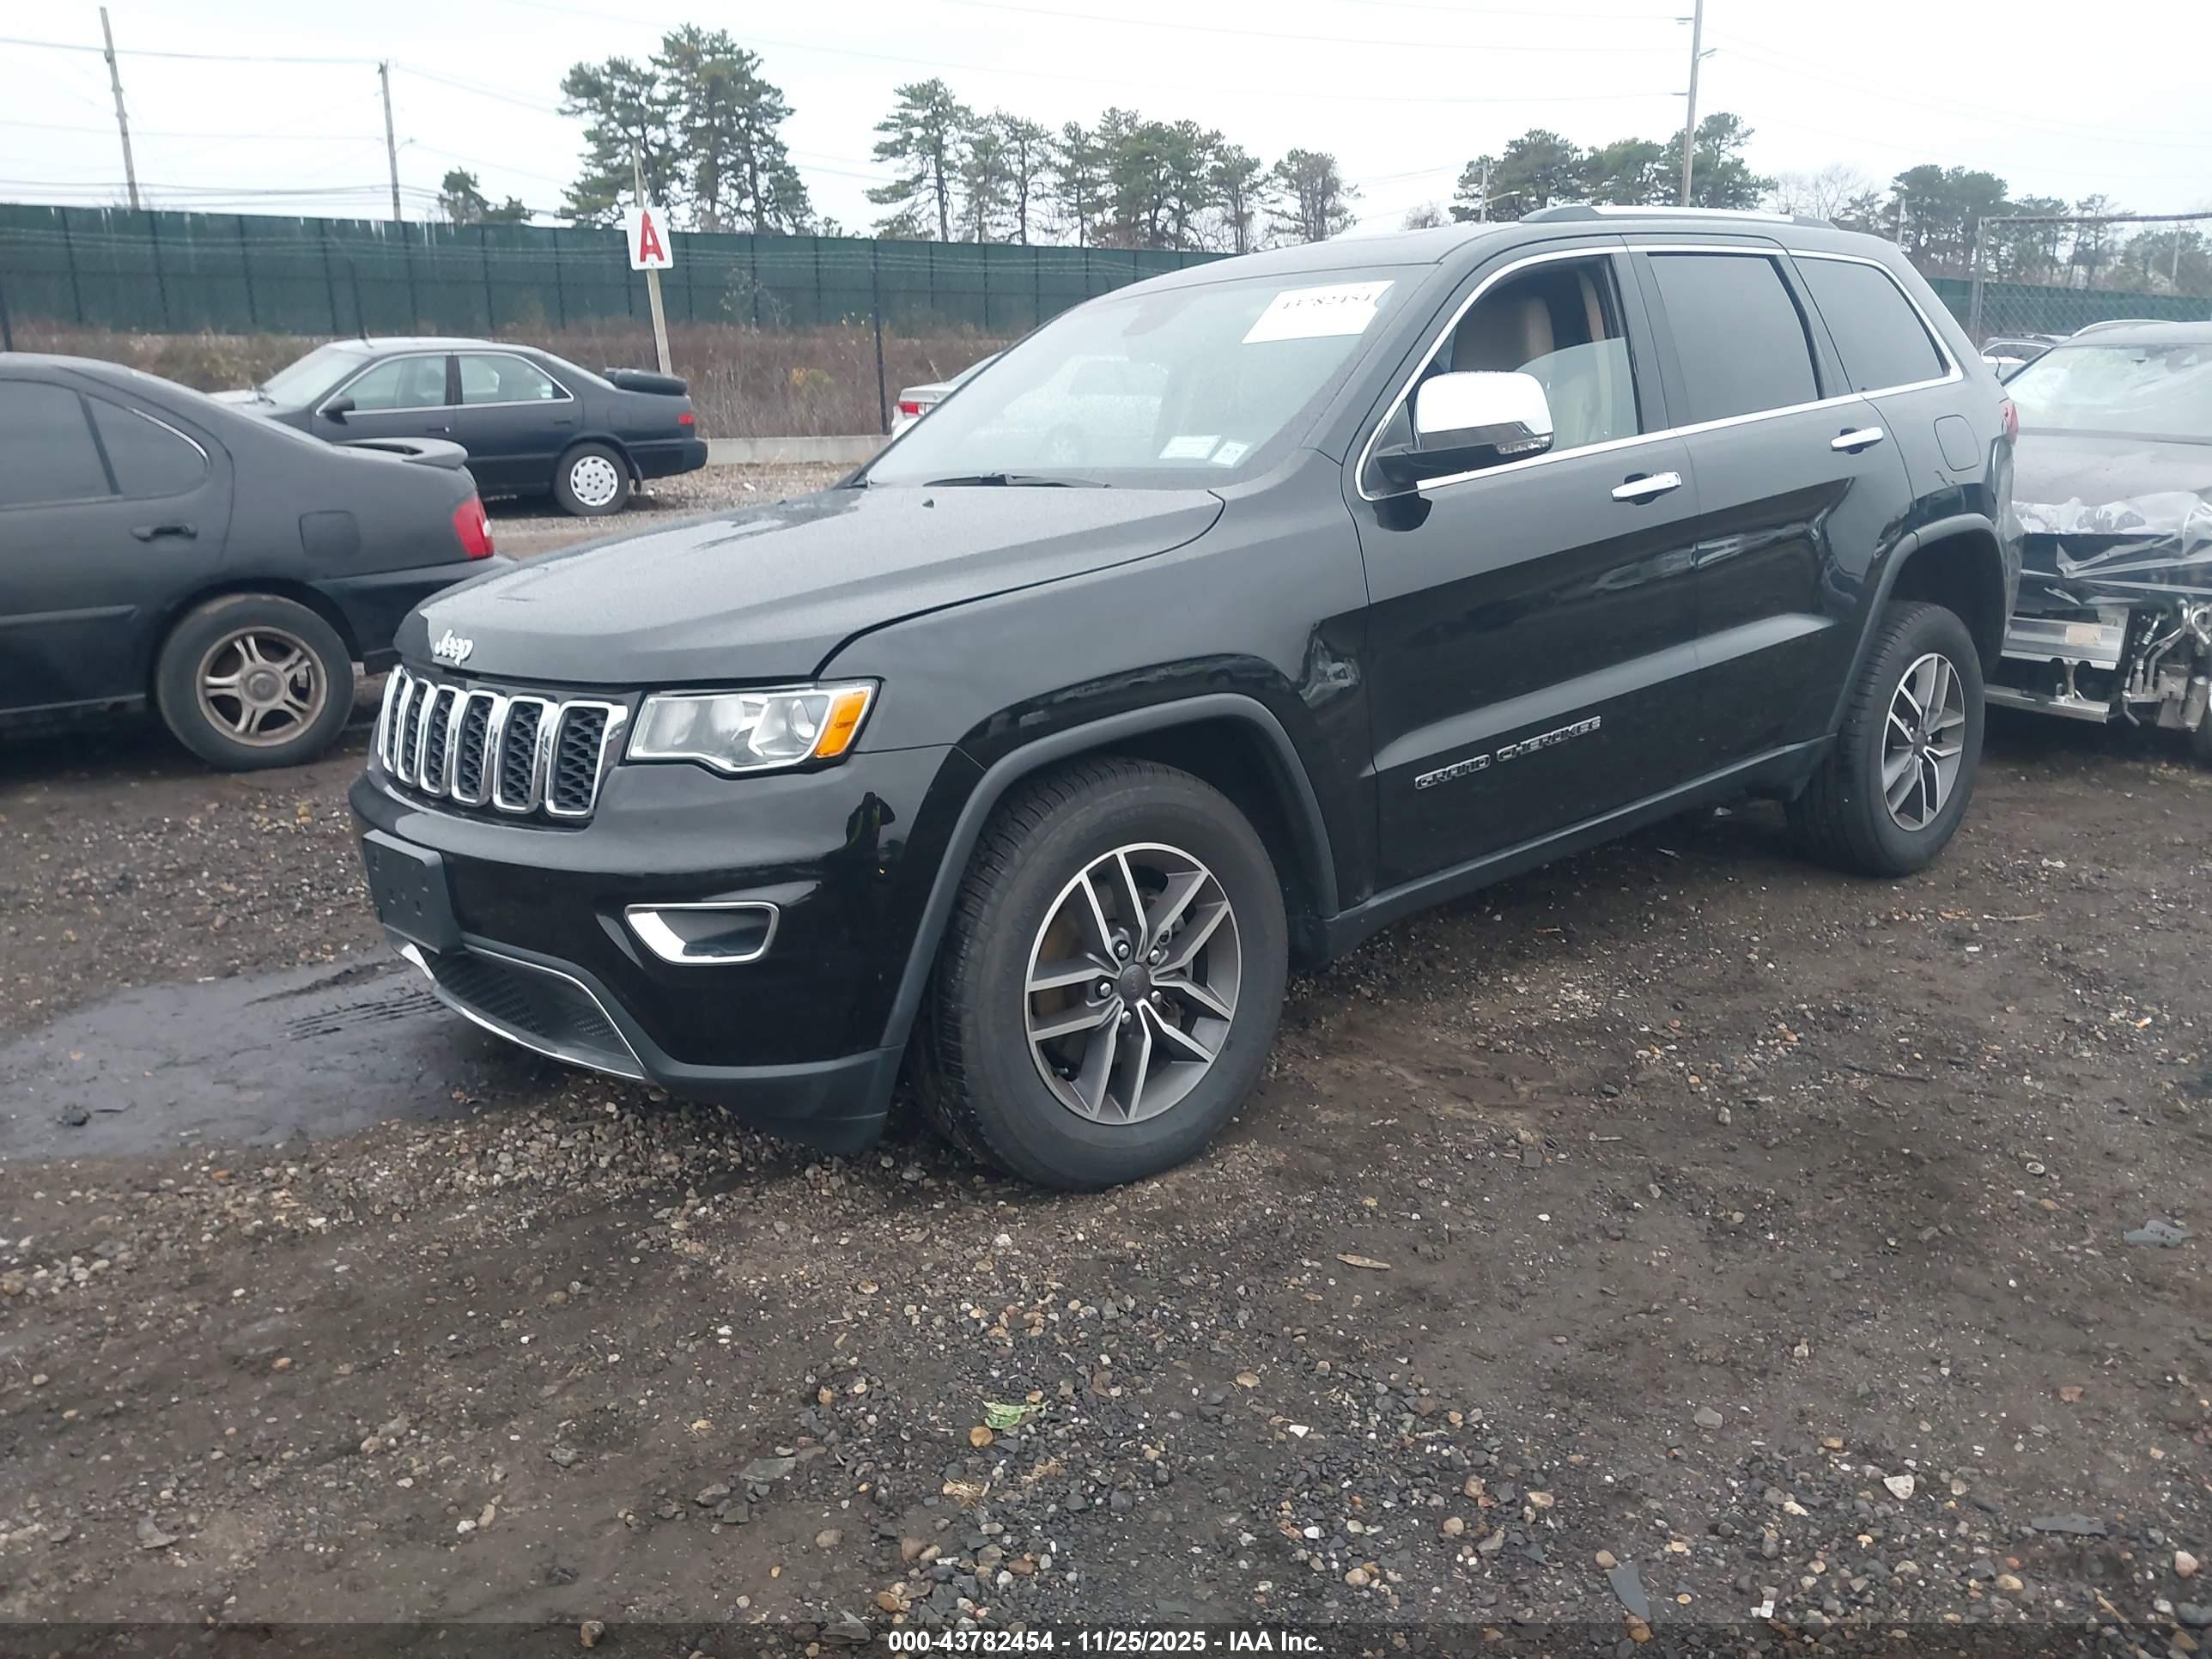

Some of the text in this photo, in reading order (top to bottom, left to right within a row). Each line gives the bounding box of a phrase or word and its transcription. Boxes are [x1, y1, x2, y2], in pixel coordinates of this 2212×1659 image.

[640, 210, 665, 262] A
[434, 629, 473, 666] Jeep
[1415, 715, 1601, 789] GRAND CHEROKEE
